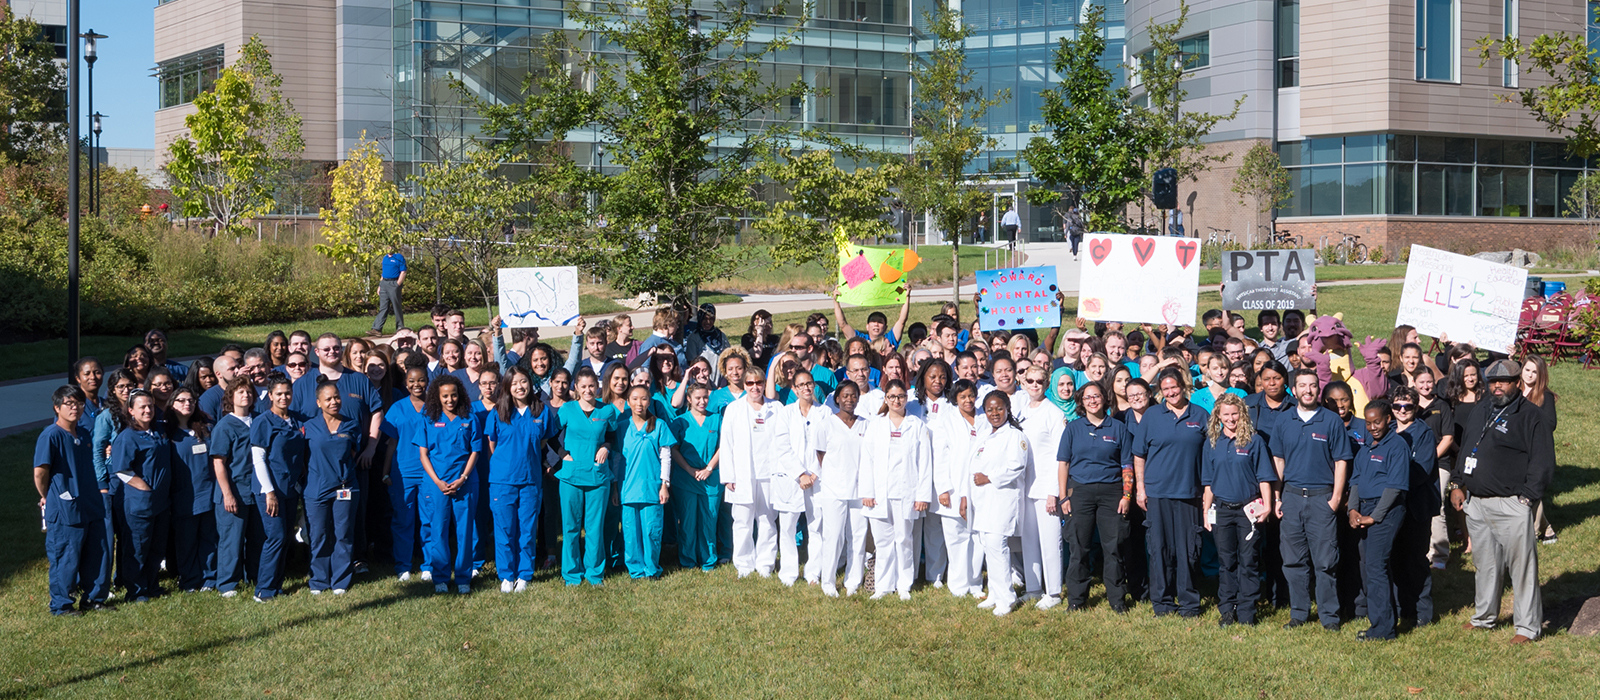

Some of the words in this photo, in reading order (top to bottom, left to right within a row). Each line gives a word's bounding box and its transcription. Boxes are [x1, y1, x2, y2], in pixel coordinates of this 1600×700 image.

[1230, 251, 1305, 281] PTA
[992, 273, 1042, 288] HOWARD
[995, 290, 1048, 300] DENTAL
[991, 304, 1049, 315] HYGIENE
[1242, 300, 1264, 310] CLASS
[1265, 300, 1276, 310] OF
[1276, 300, 1294, 310] 2019
